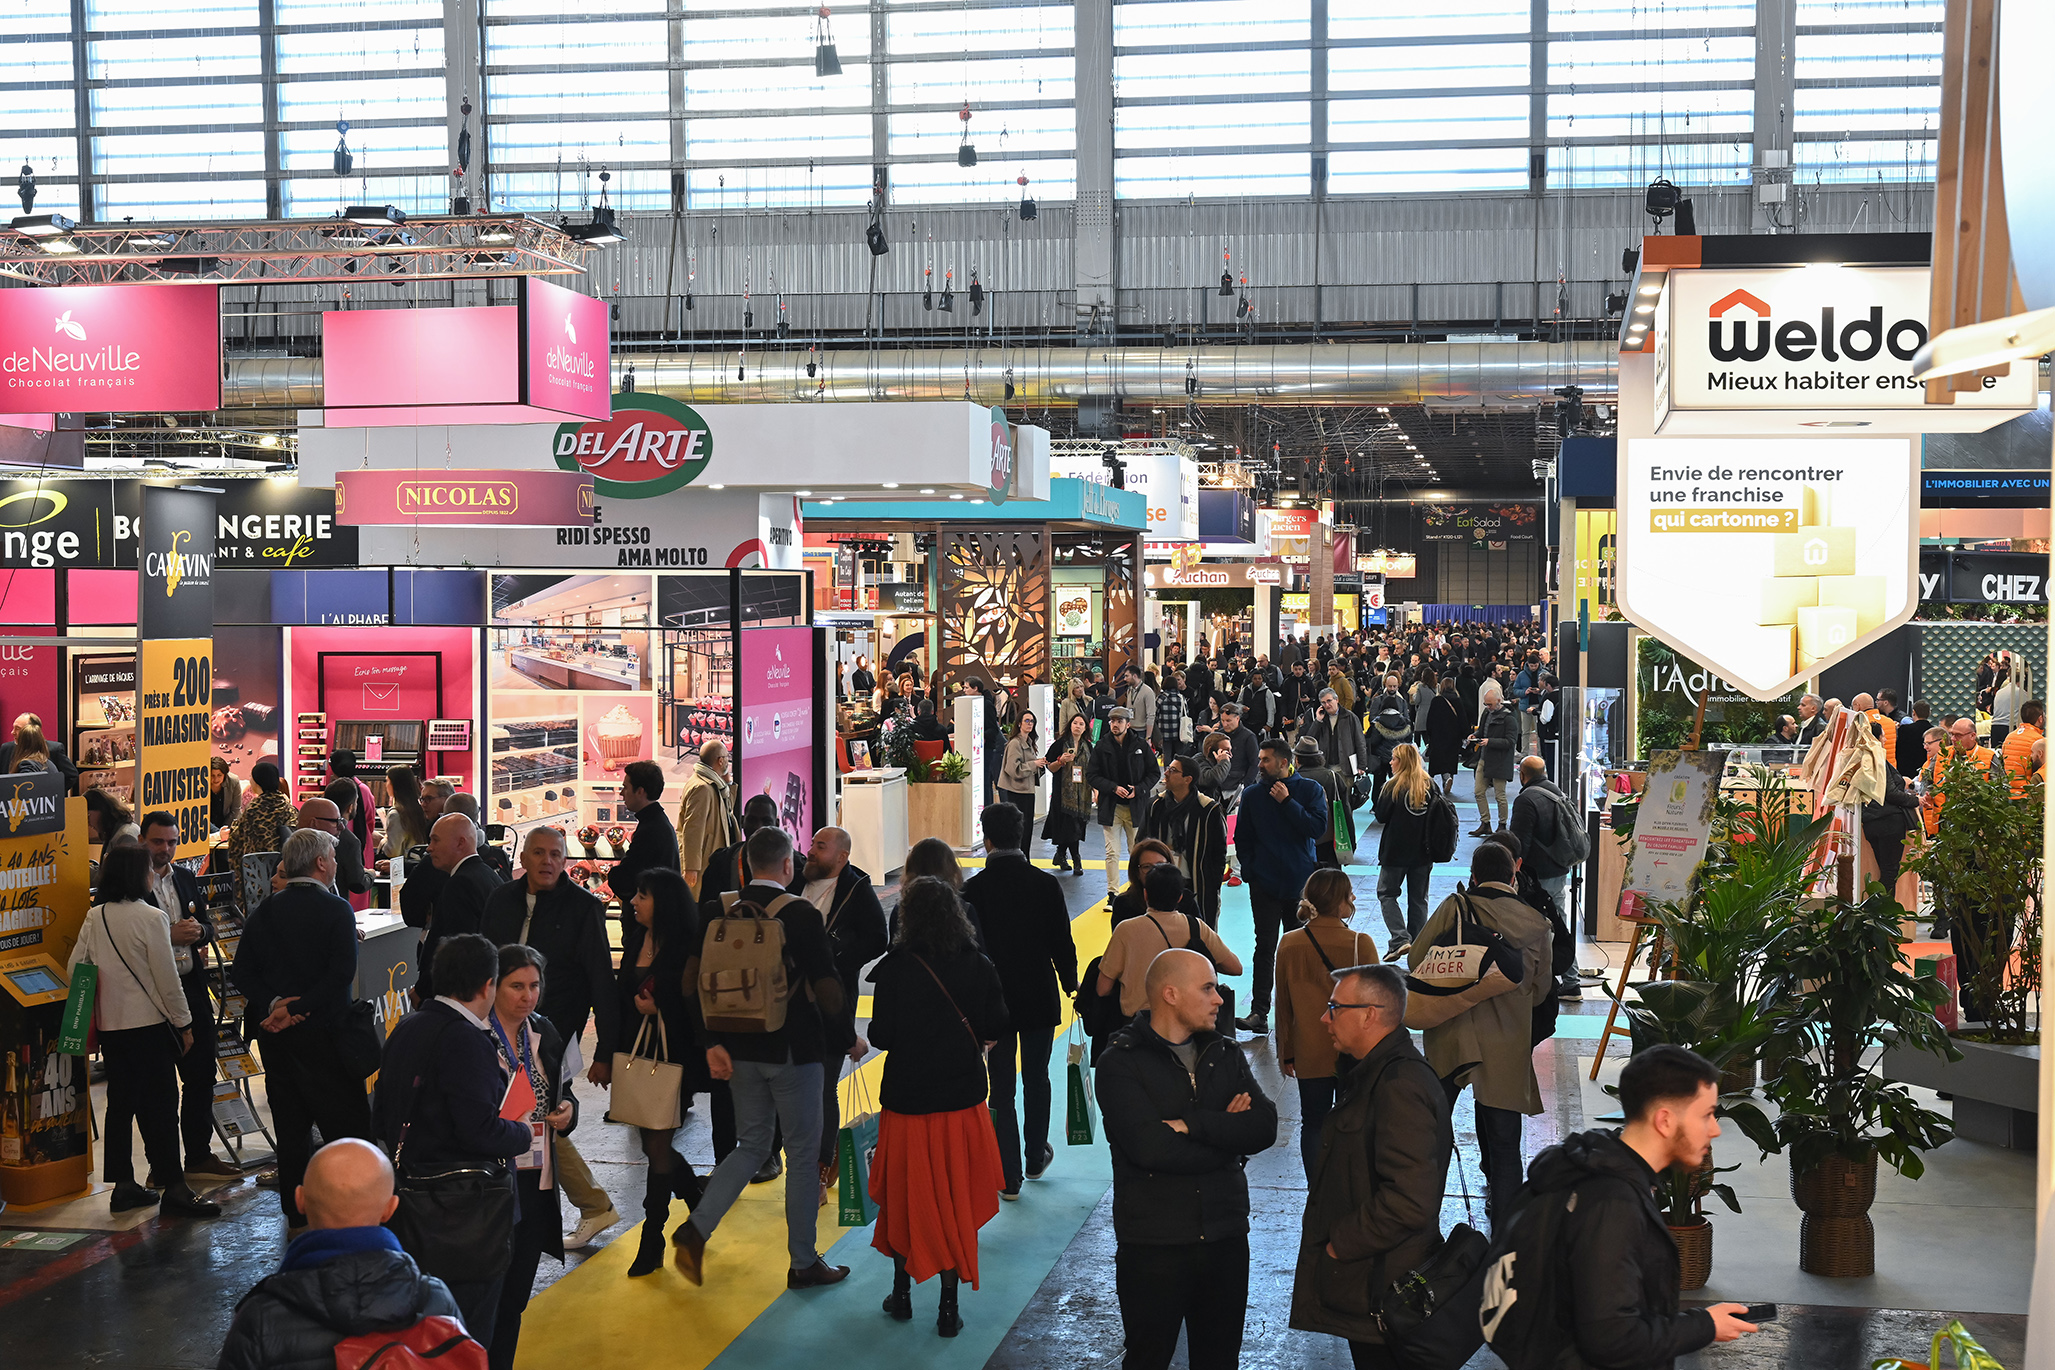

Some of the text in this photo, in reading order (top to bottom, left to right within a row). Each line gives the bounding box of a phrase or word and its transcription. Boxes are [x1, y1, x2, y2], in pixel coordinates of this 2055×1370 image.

[2, 345, 140, 372] deNeuville
[8, 377, 135, 388] Chocolat français
[1707, 372, 1777, 390] Mieux
[1785, 371, 1870, 390] habiter
[1650, 465, 1844, 481] Envie de rencontrer
[2001, 479, 2031, 488] AVEC
[2033, 479, 2050, 488] UN
[405, 487, 511, 506] NICOLAS
[1650, 487, 1784, 502] une franchise
[1653, 511, 1794, 531] qui cartonne ?
[556, 527, 650, 546] RIDI SPESSO
[262, 534, 315, 566] café
[617, 548, 708, 566] AMA MOLTO
[145, 552, 211, 577] CAVAVIN
[1981, 574, 2040, 600] CHEZ
[173, 656, 210, 707] 200
[144, 690, 170, 709] PRÈS DE
[1707, 694, 1748, 702] immobilier
[144, 712, 209, 747] MAGASINS
[143, 765, 208, 807] CAVISTES
[8, 843, 56, 870] 40 ANS
[12, 887, 40, 911] LOTS
[12, 937, 19, 947] DE
[20, 934, 36, 946] JOUER
[44, 1052, 72, 1091] 40
[40, 1085, 76, 1119] ANS
